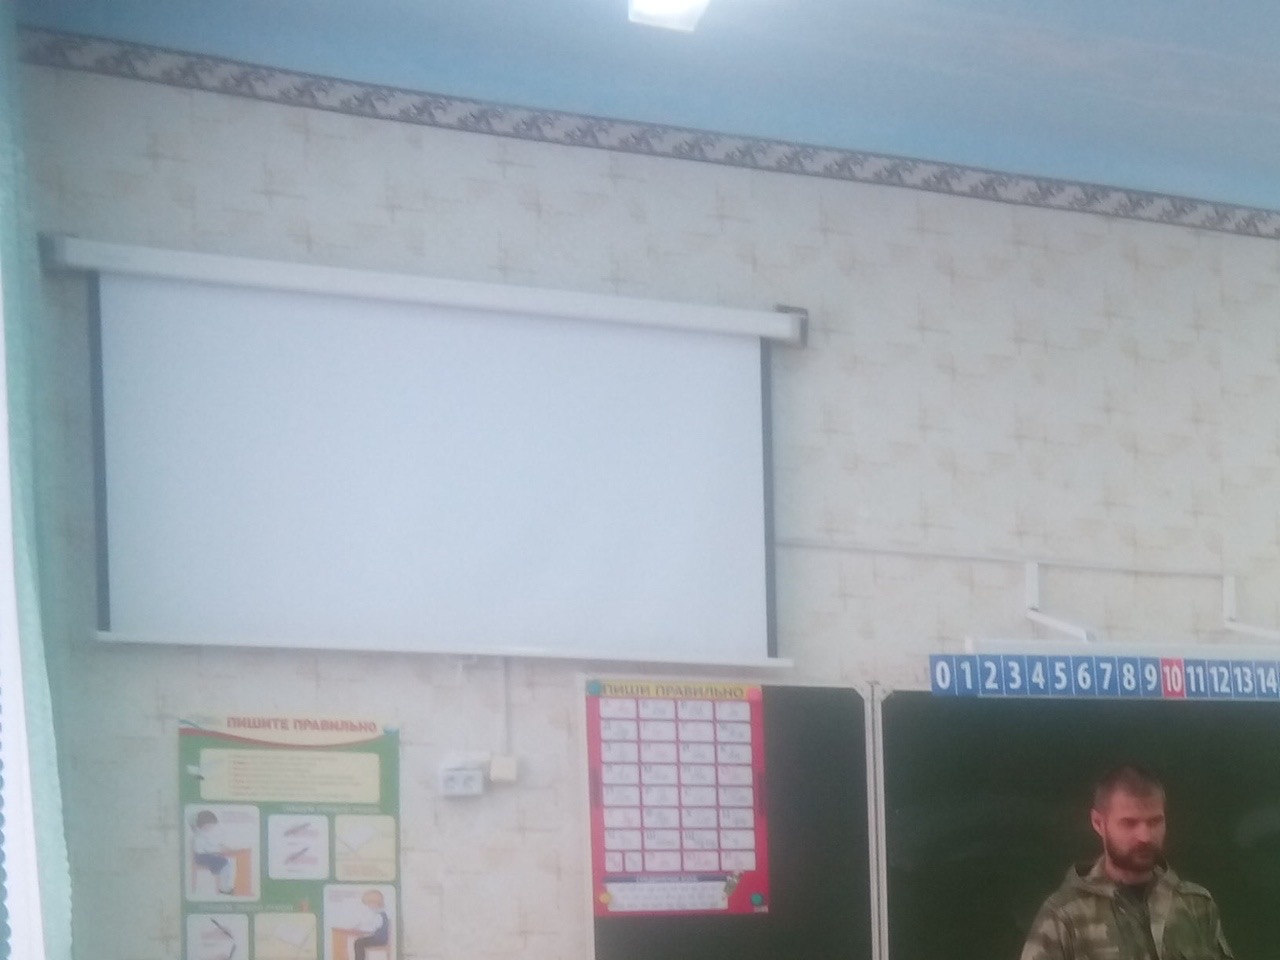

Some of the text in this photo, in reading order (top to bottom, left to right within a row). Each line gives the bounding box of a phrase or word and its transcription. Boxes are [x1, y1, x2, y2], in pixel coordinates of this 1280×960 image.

[936, 661, 950, 689] 0
[960, 661, 972, 689] 1
[984, 661, 998, 689] 2
[1008, 661, 1021, 689] 3
[1032, 661, 1045, 689] 4
[1054, 662, 1067, 690] 5
[1077, 662, 1091, 690] 6
[1100, 662, 1112, 690] 7
[1123, 663, 1136, 690] 8
[1144, 663, 1157, 690] 9
[1164, 665, 1182, 692] 10
[1186, 665, 1205, 693] 11
[1209, 666, 1231, 693] 12
[1233, 666, 1253, 694] 13
[1256, 667, 1277, 694] 14
[655, 684, 744, 699] ПРАВИЛЬНО
[226, 716, 377, 733] ПИШИТЕ ПРАВИЛЬНО
